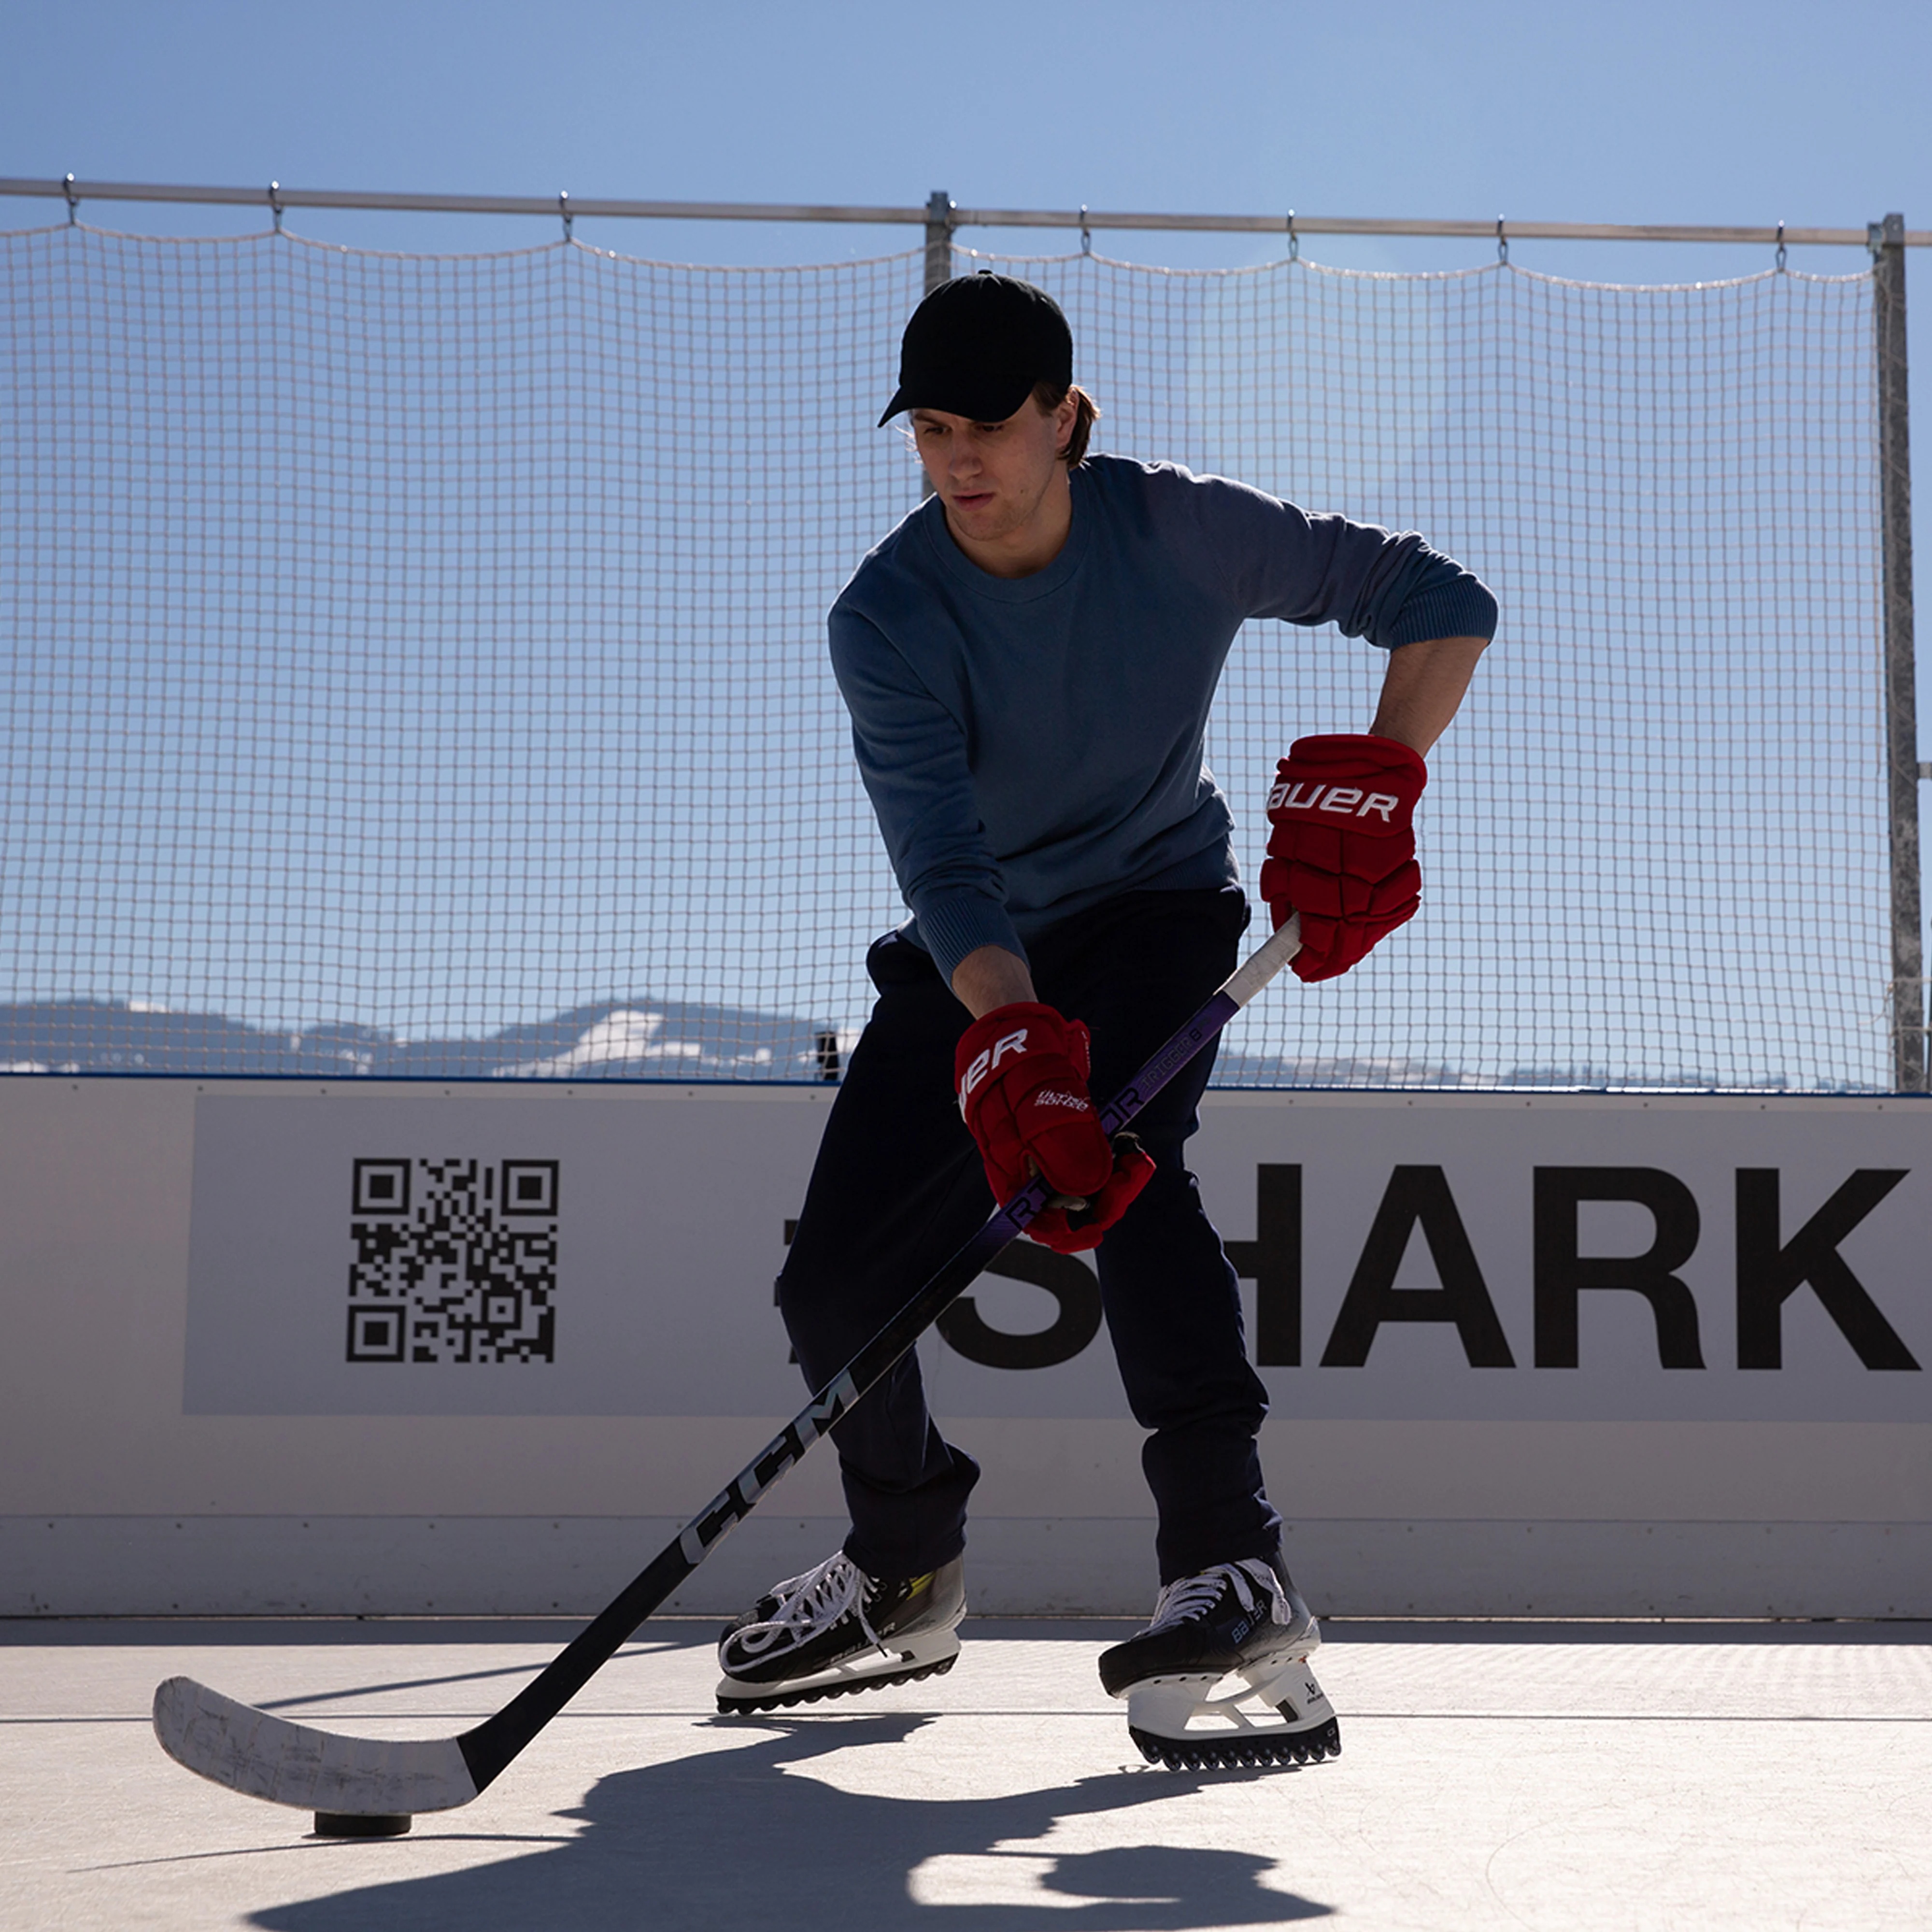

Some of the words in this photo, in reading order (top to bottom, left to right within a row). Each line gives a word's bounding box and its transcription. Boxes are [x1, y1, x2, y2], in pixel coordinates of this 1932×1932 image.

[1266, 782, 1399, 823] AUER
[774, 1163, 1923, 1371] SHARK
[679, 1368, 860, 1564] CCM
